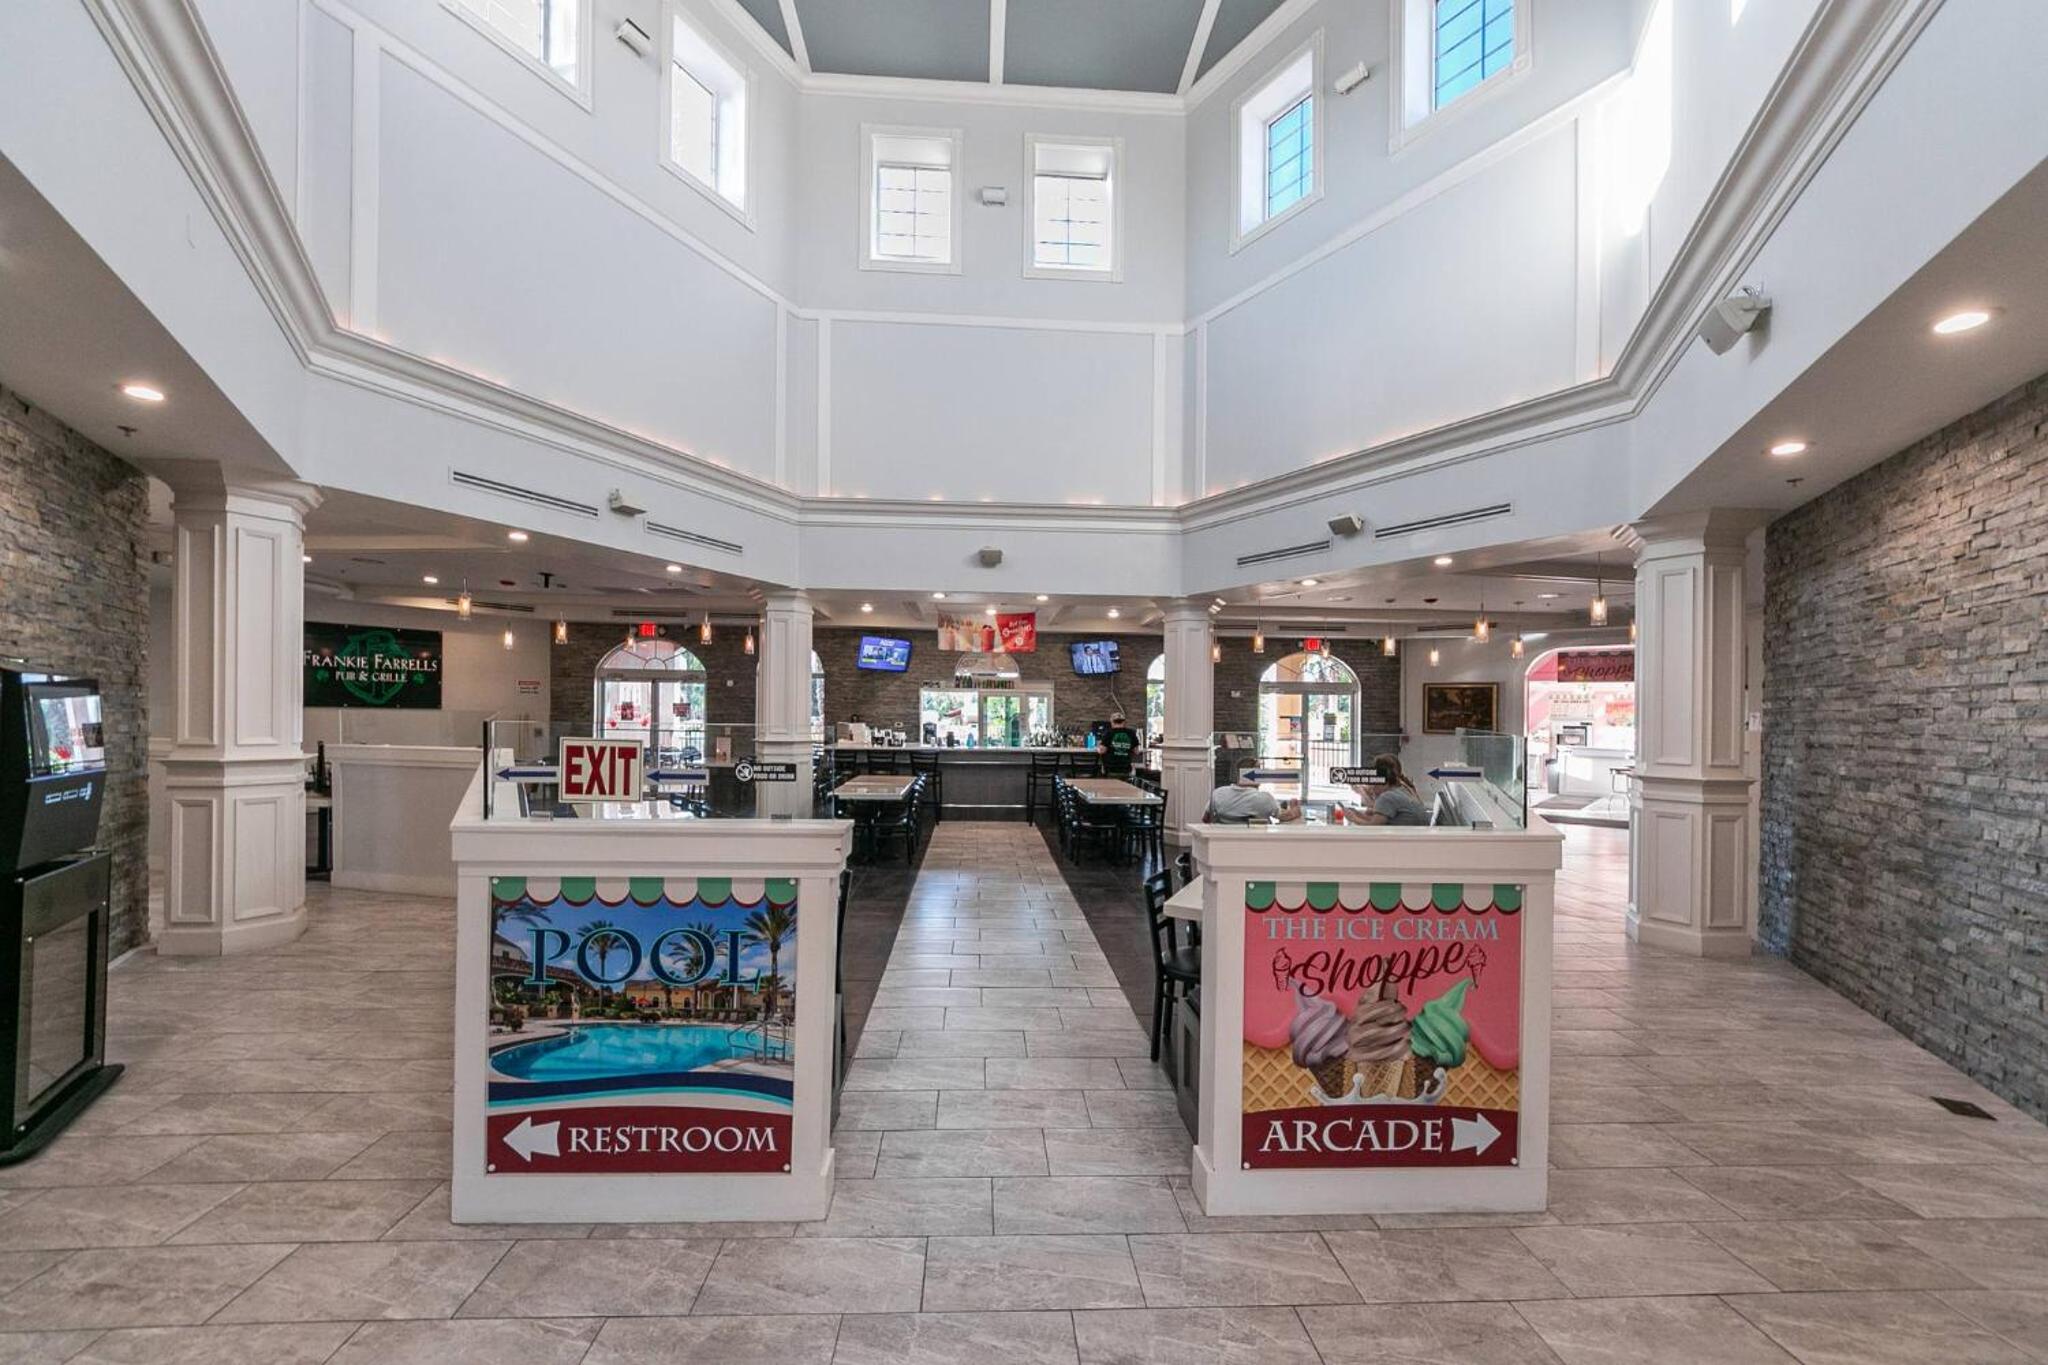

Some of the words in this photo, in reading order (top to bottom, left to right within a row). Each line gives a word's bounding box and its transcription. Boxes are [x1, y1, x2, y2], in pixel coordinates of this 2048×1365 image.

[303, 650, 369, 669] FRANKIE
[374, 653, 438, 672] FARRELLS
[335, 670, 356, 681] PUB
[358, 671, 372, 682] &
[372, 671, 408, 683] GRILLE
[565, 745, 637, 796] EXIT
[1262, 916, 1328, 941] THE
[1336, 916, 1386, 940] ICE
[1393, 917, 1499, 941] CREAM
[523, 927, 762, 994] POOL
[1288, 941, 1469, 1001] Shoppe
[567, 1125, 777, 1154] RESTROOM
[1259, 1117, 1444, 1153] ARCADE
